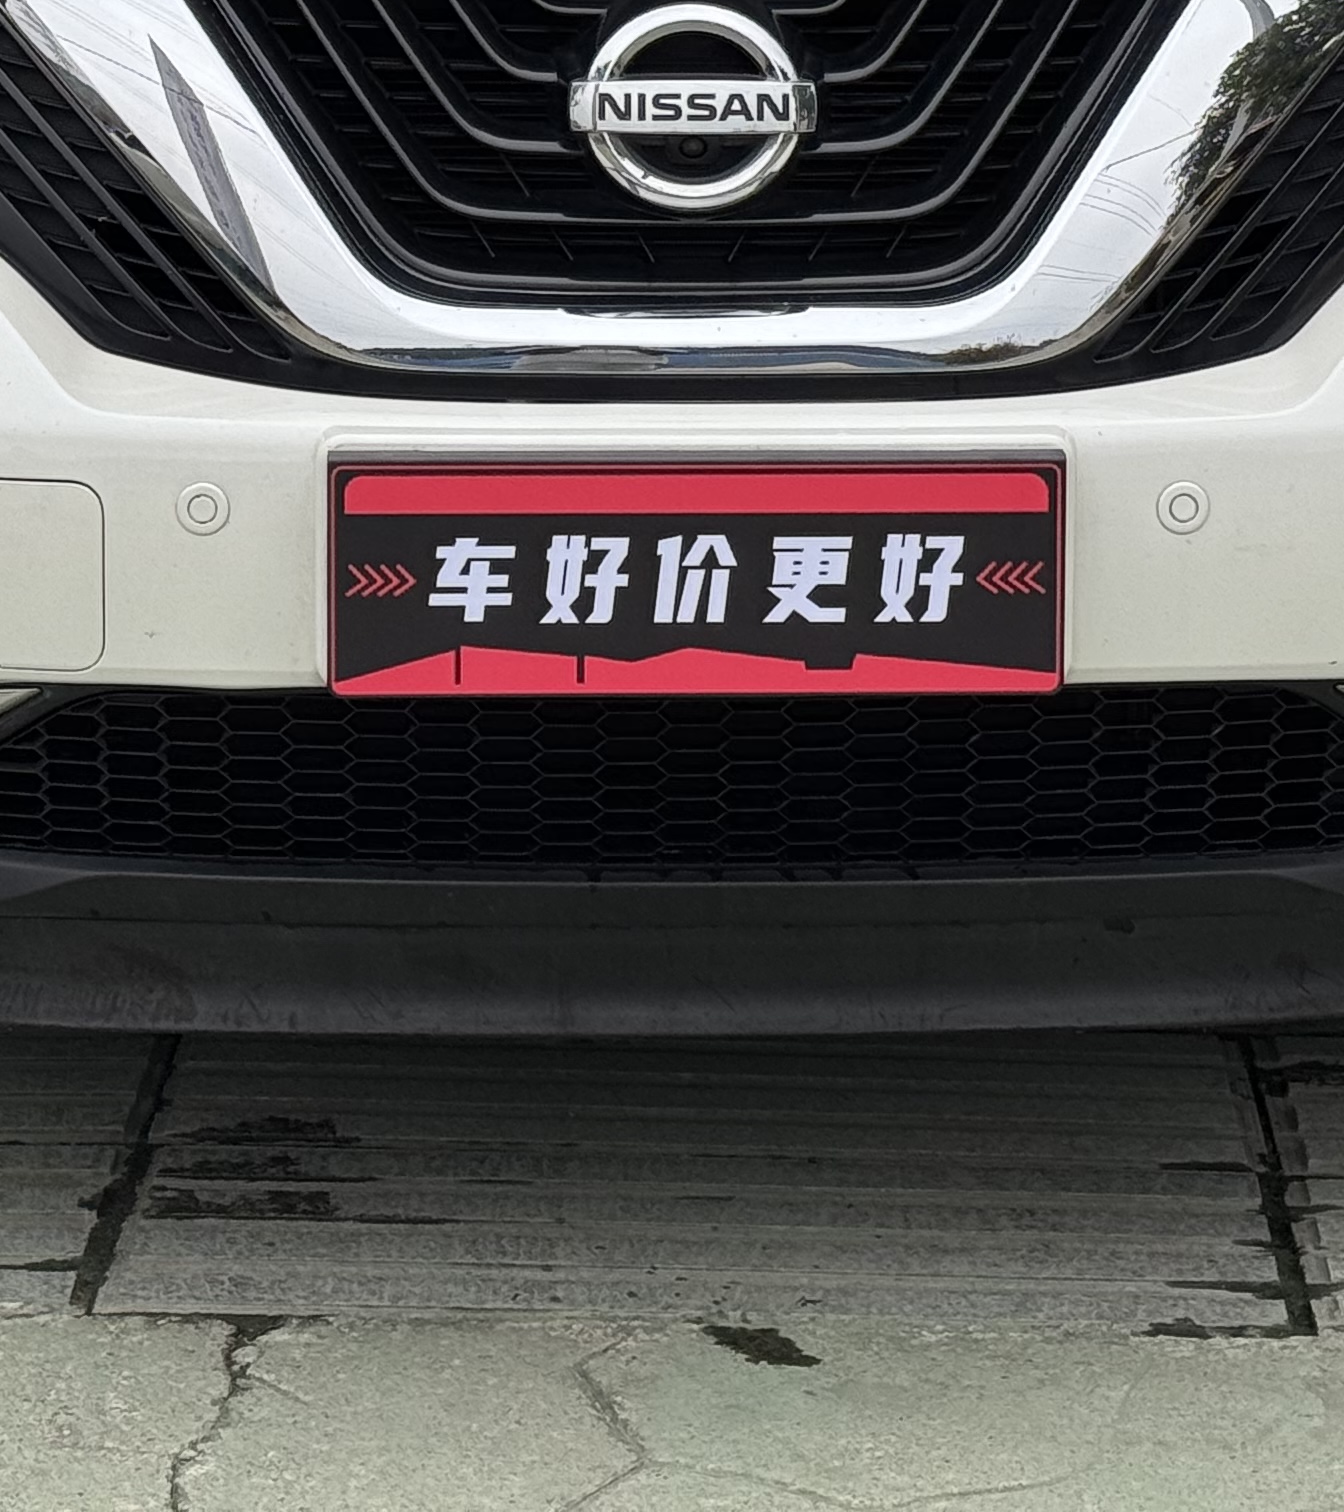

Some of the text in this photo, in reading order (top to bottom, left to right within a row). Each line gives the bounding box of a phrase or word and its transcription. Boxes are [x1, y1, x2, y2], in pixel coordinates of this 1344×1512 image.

[598, 92, 791, 122] NISSAN
[428, 533, 966, 624] 车好价更好
